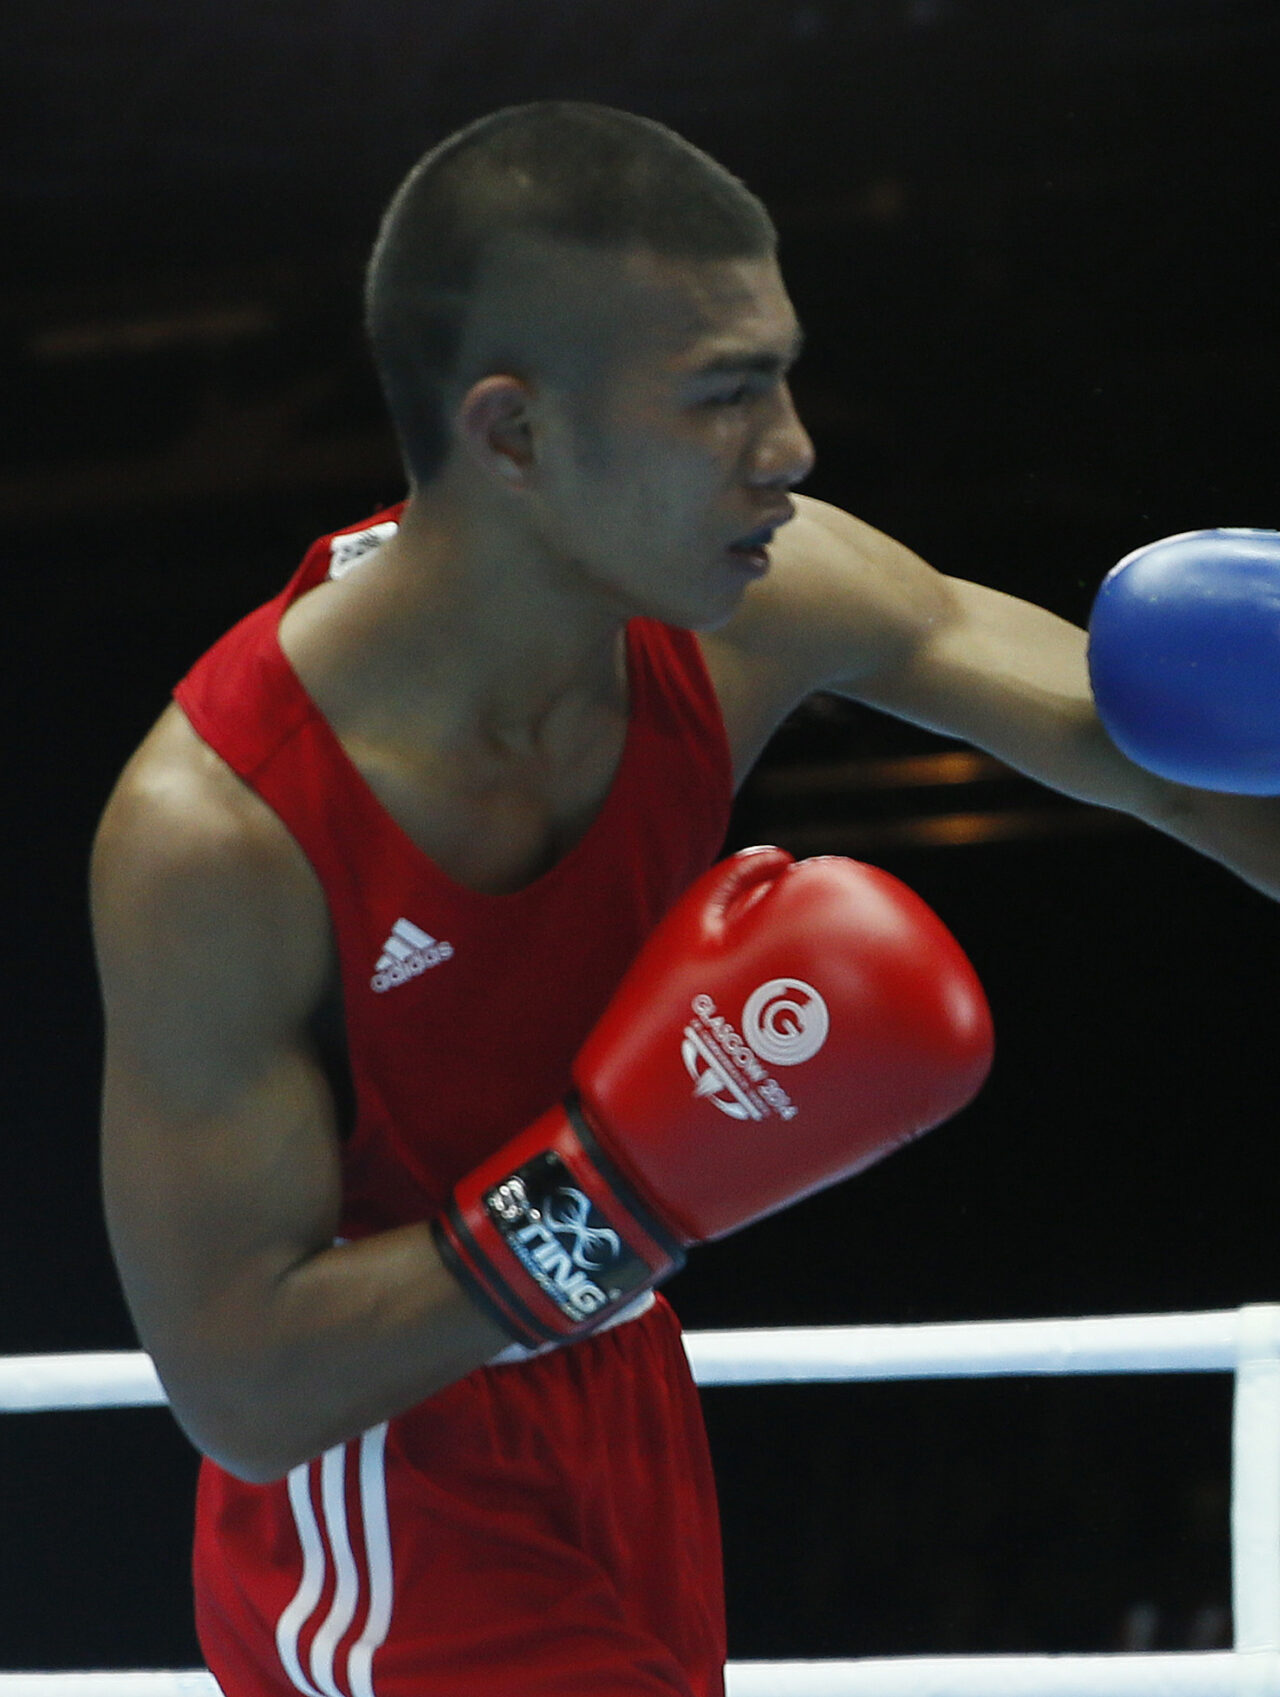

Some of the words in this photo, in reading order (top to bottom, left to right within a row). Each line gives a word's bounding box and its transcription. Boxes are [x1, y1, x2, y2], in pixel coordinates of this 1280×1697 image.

[370, 941, 455, 993] adidas
[691, 994, 769, 1082] GLASGOW
[756, 1078, 798, 1121] 2014
[487, 1176, 608, 1316] STING
